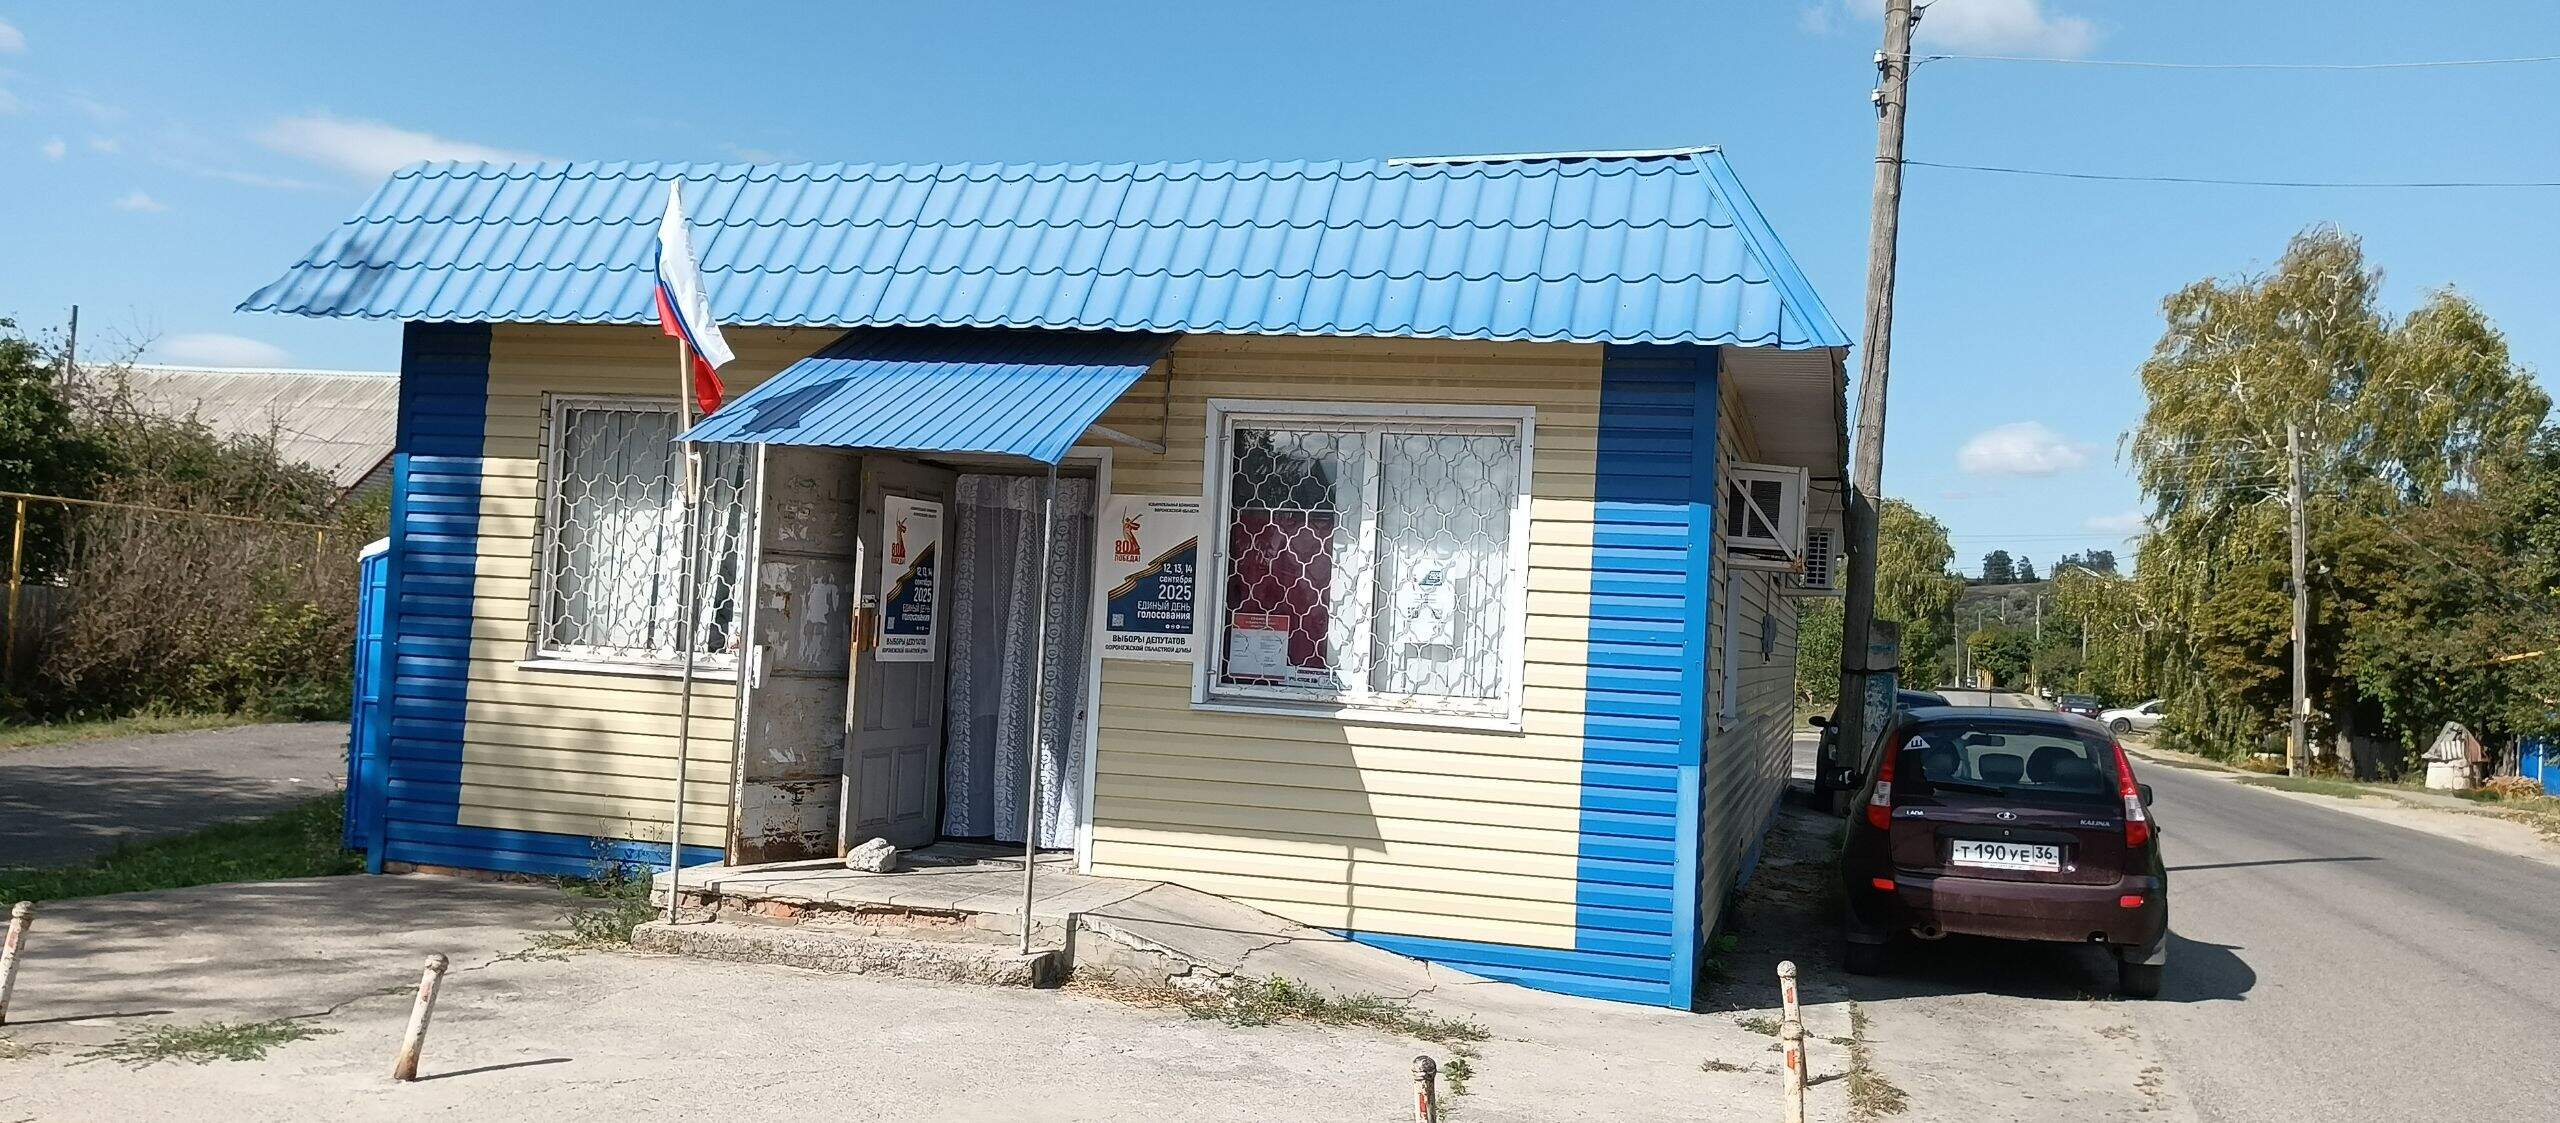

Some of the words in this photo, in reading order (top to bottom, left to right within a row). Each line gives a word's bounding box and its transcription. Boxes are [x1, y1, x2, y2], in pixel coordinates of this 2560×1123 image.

[1115, 540, 1129, 552] 80
[1174, 563, 1183, 574] 13,
[1185, 564, 1193, 574] 14
[1159, 575, 1193, 584] сентября
[913, 586, 932, 602] 2025
[1158, 583, 1192, 600] 2025
[1137, 600, 1170, 610] ЕДИНЫЙ
[1171, 602, 1191, 612] ДЕНЬ
[1137, 610, 1191, 620] голосования
[1112, 634, 1145, 644] ВЫБОРЫ
[1145, 636, 1186, 645] ДЕПУТАТОВ
[2035, 846, 2053, 860] 36
